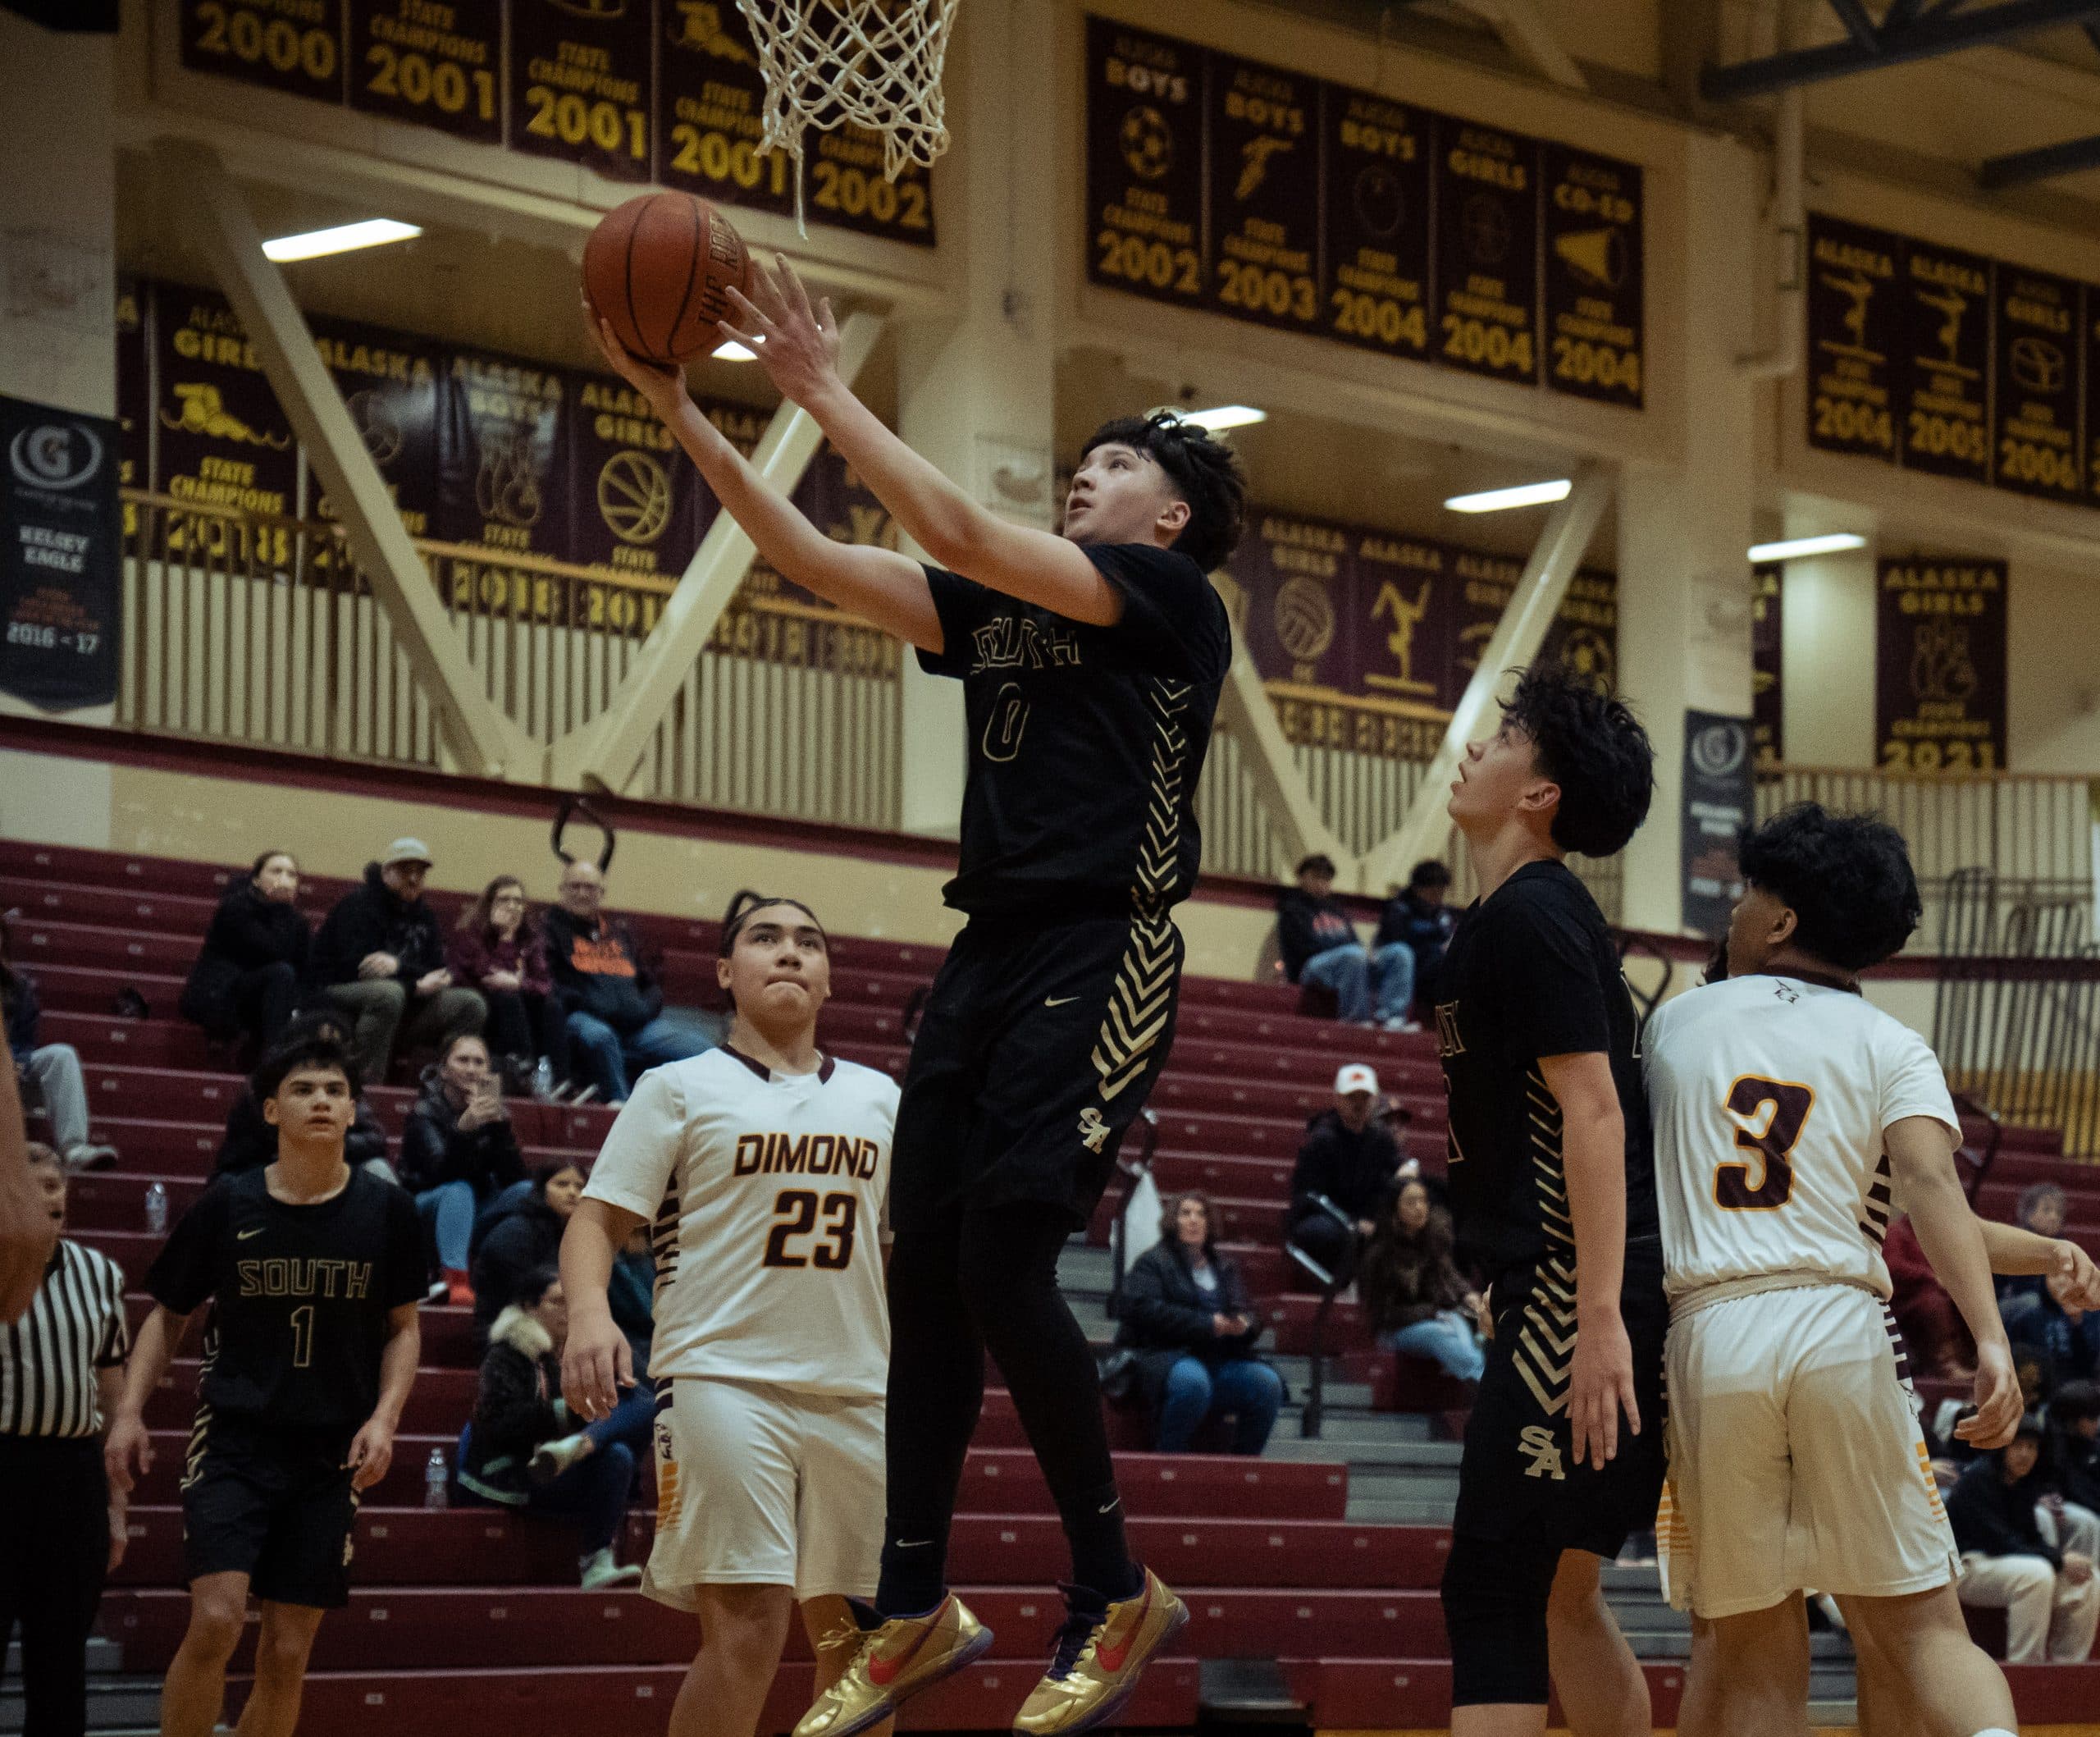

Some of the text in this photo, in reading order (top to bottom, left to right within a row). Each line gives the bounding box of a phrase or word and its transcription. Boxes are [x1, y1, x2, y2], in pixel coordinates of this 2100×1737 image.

[195, 2, 337, 81] 2000
[369, 13, 486, 65] CHAMPIONS
[365, 43, 495, 121] 2001
[528, 56, 640, 104] CHAMPIONS
[1105, 56, 1188, 105] BOYS
[526, 85, 646, 159] 2001
[1226, 90, 1305, 136] BOYS
[1340, 119, 1417, 162] BOYS
[671, 123, 788, 196] 2001
[812, 159, 929, 230] 2002
[1097, 230, 1200, 295] 2002
[1217, 259, 1317, 322] 2003
[1331, 288, 1427, 350] 2004
[1440, 314, 1533, 374] 2004
[172, 327, 262, 372] GIRL
[1553, 337, 1640, 392] 2004
[594, 413, 674, 451] GIRLS
[200, 456, 255, 488] STATE
[1885, 568, 1999, 591] ALASKA
[1898, 591, 1985, 615] GIRLS
[6, 620, 57, 649] 2016
[75, 630, 100, 656] 17
[981, 680, 1031, 763] 0
[1883, 741, 1997, 778] 2021
[734, 1132, 879, 1181] DIMOND
[1713, 1073, 1816, 1213] 3
[762, 1190, 858, 1271] 23
[236, 1257, 373, 1300] SOUTH
[289, 1305, 316, 1369] 1
[1517, 1424, 1567, 1481] SA
